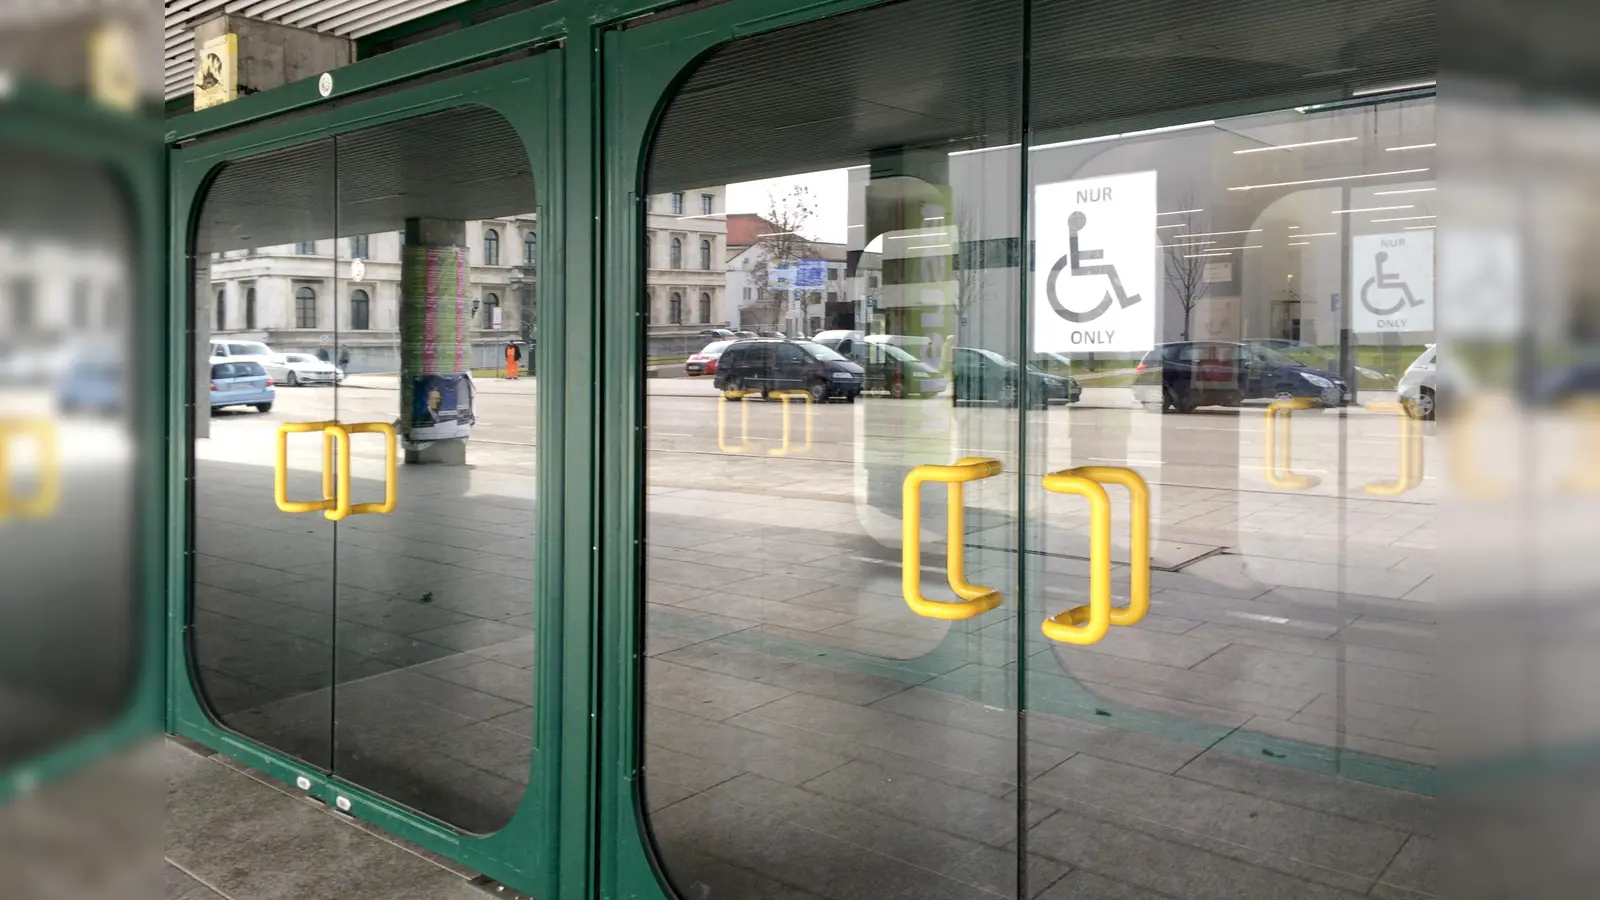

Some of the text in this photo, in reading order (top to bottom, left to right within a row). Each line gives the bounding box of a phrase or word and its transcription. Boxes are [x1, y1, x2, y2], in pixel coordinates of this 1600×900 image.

[1076, 186, 1112, 204] NUR
[1380, 238, 1406, 248] NUR
[1377, 319, 1408, 329] ONLY
[1071, 330, 1115, 345] ONLY
